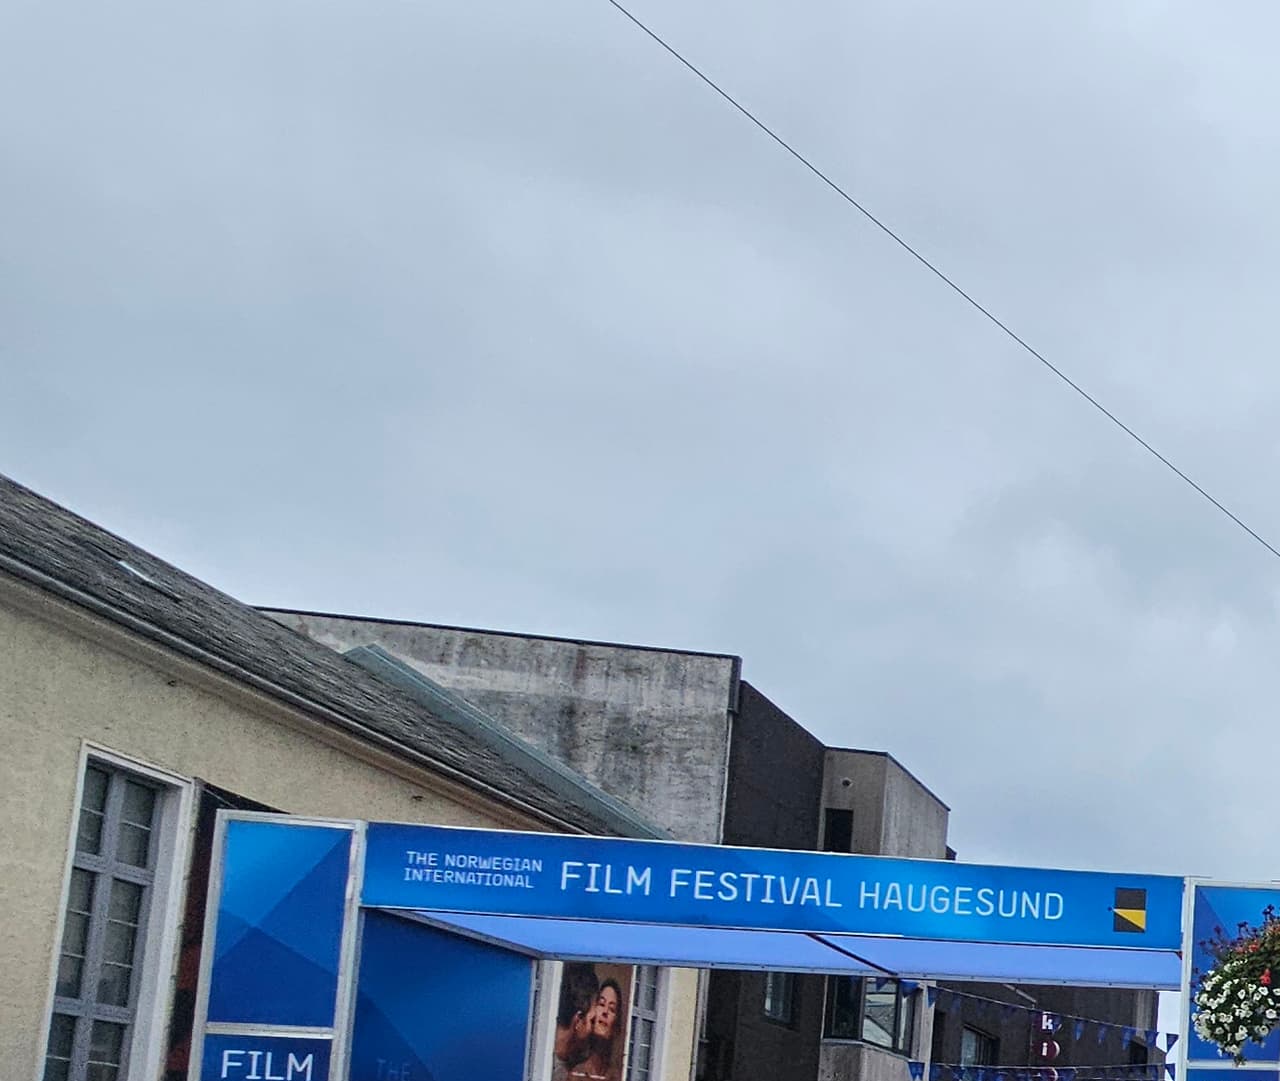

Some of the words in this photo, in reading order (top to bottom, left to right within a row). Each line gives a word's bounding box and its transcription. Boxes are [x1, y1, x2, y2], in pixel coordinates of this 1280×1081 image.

[406, 851, 437, 866] THE
[444, 854, 542, 872] NORWEGIAN
[403, 868, 534, 889] INTERNATIONAL
[560, 861, 651, 896] FILM
[669, 868, 842, 908] FESTIVAL
[858, 880, 1064, 921] HAUGESUND
[221, 1049, 314, 1081] FILM
